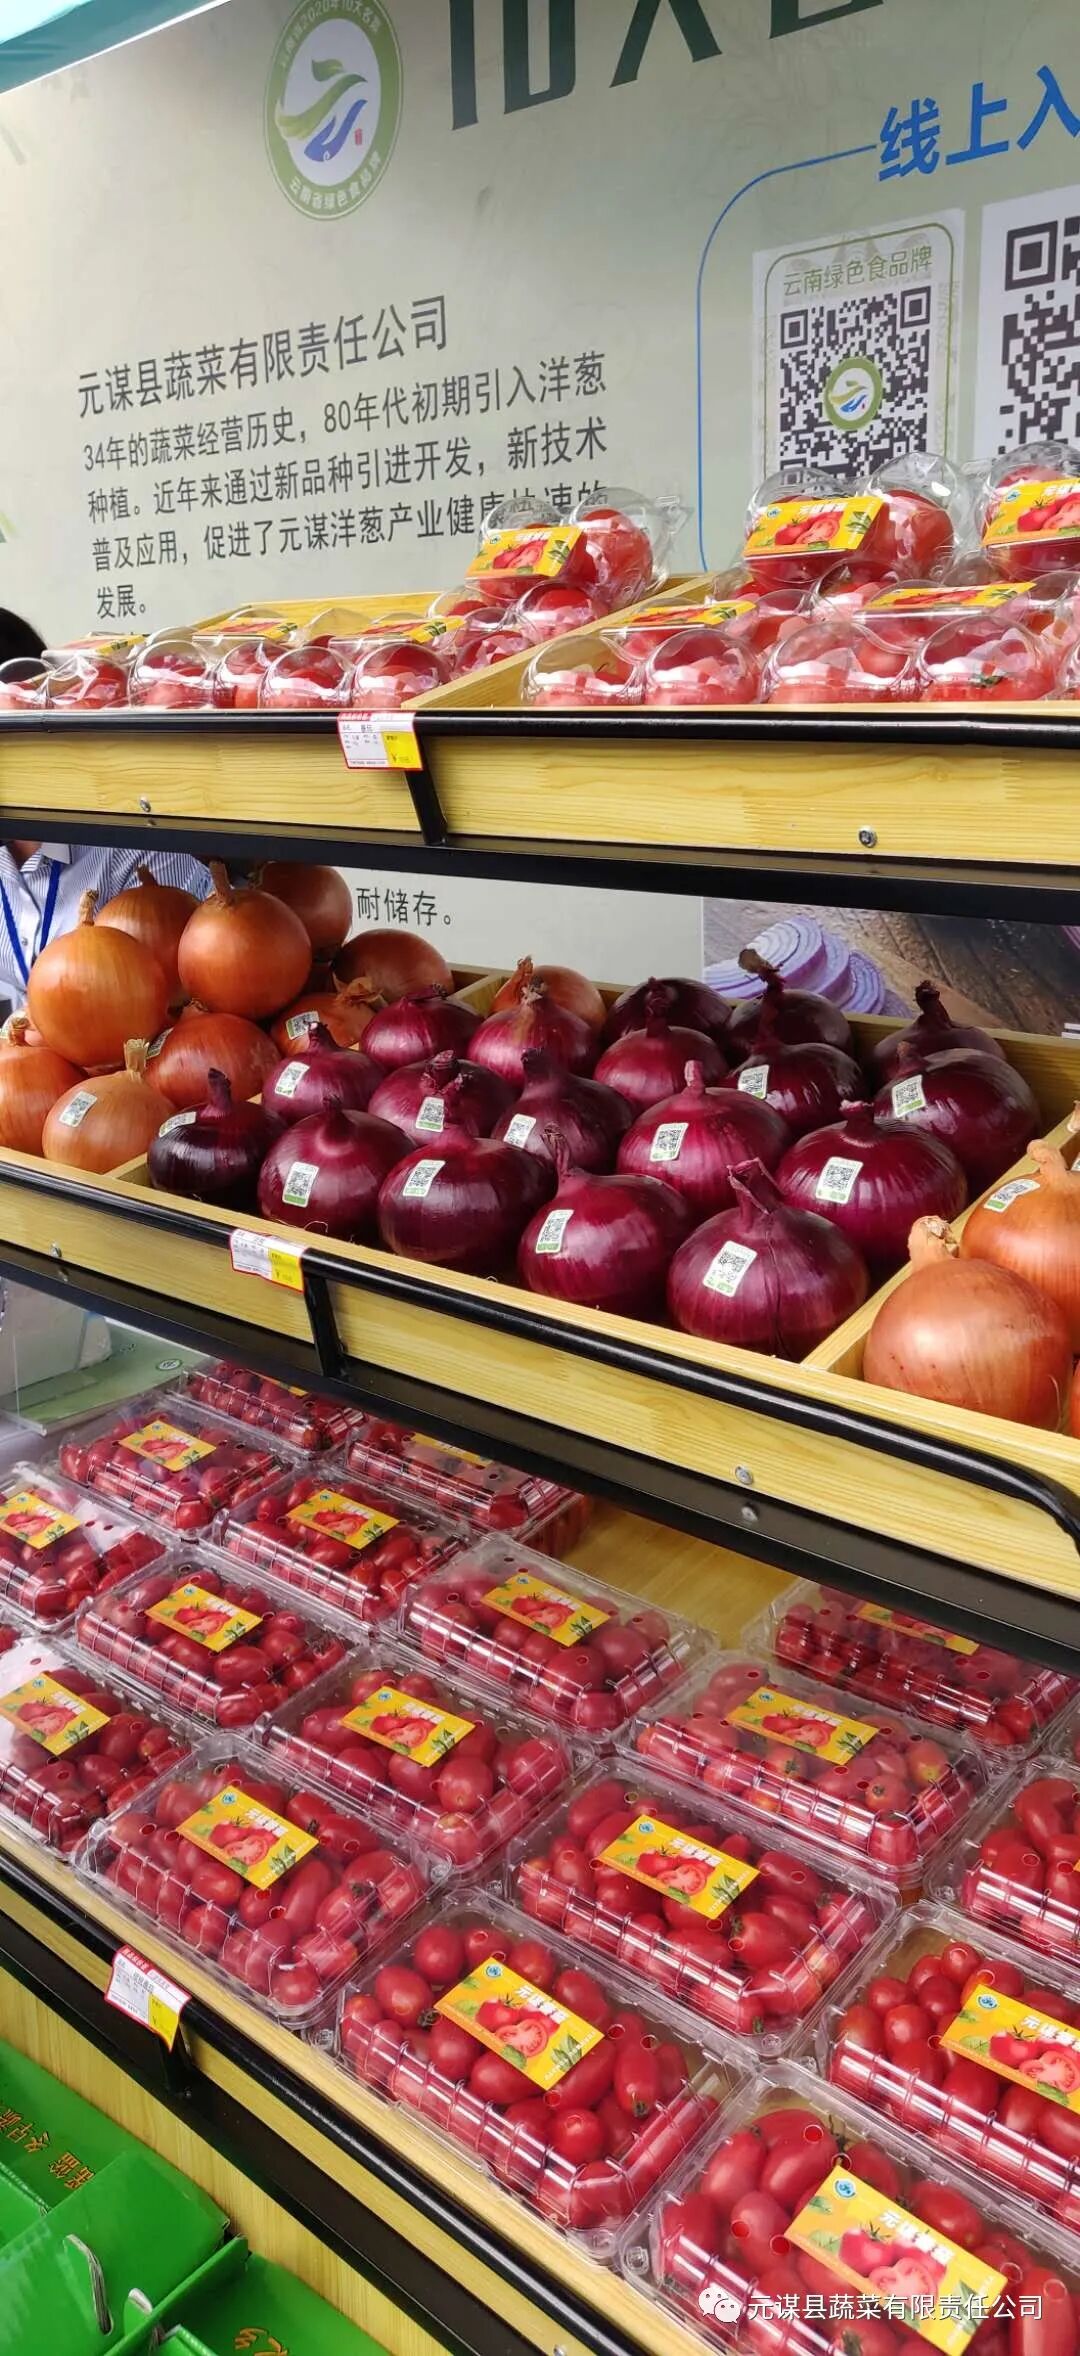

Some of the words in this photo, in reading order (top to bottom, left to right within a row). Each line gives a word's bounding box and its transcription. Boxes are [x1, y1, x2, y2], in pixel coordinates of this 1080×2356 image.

[878, 65, 1080, 182] 线上入
[784, 246, 932, 296] 云南绿色食品牌
[78, 295, 447, 418] 元谋县蔬菜有限责任公司
[96, 584, 146, 619] 发展。
[356, 887, 451, 926] 耐储存。
